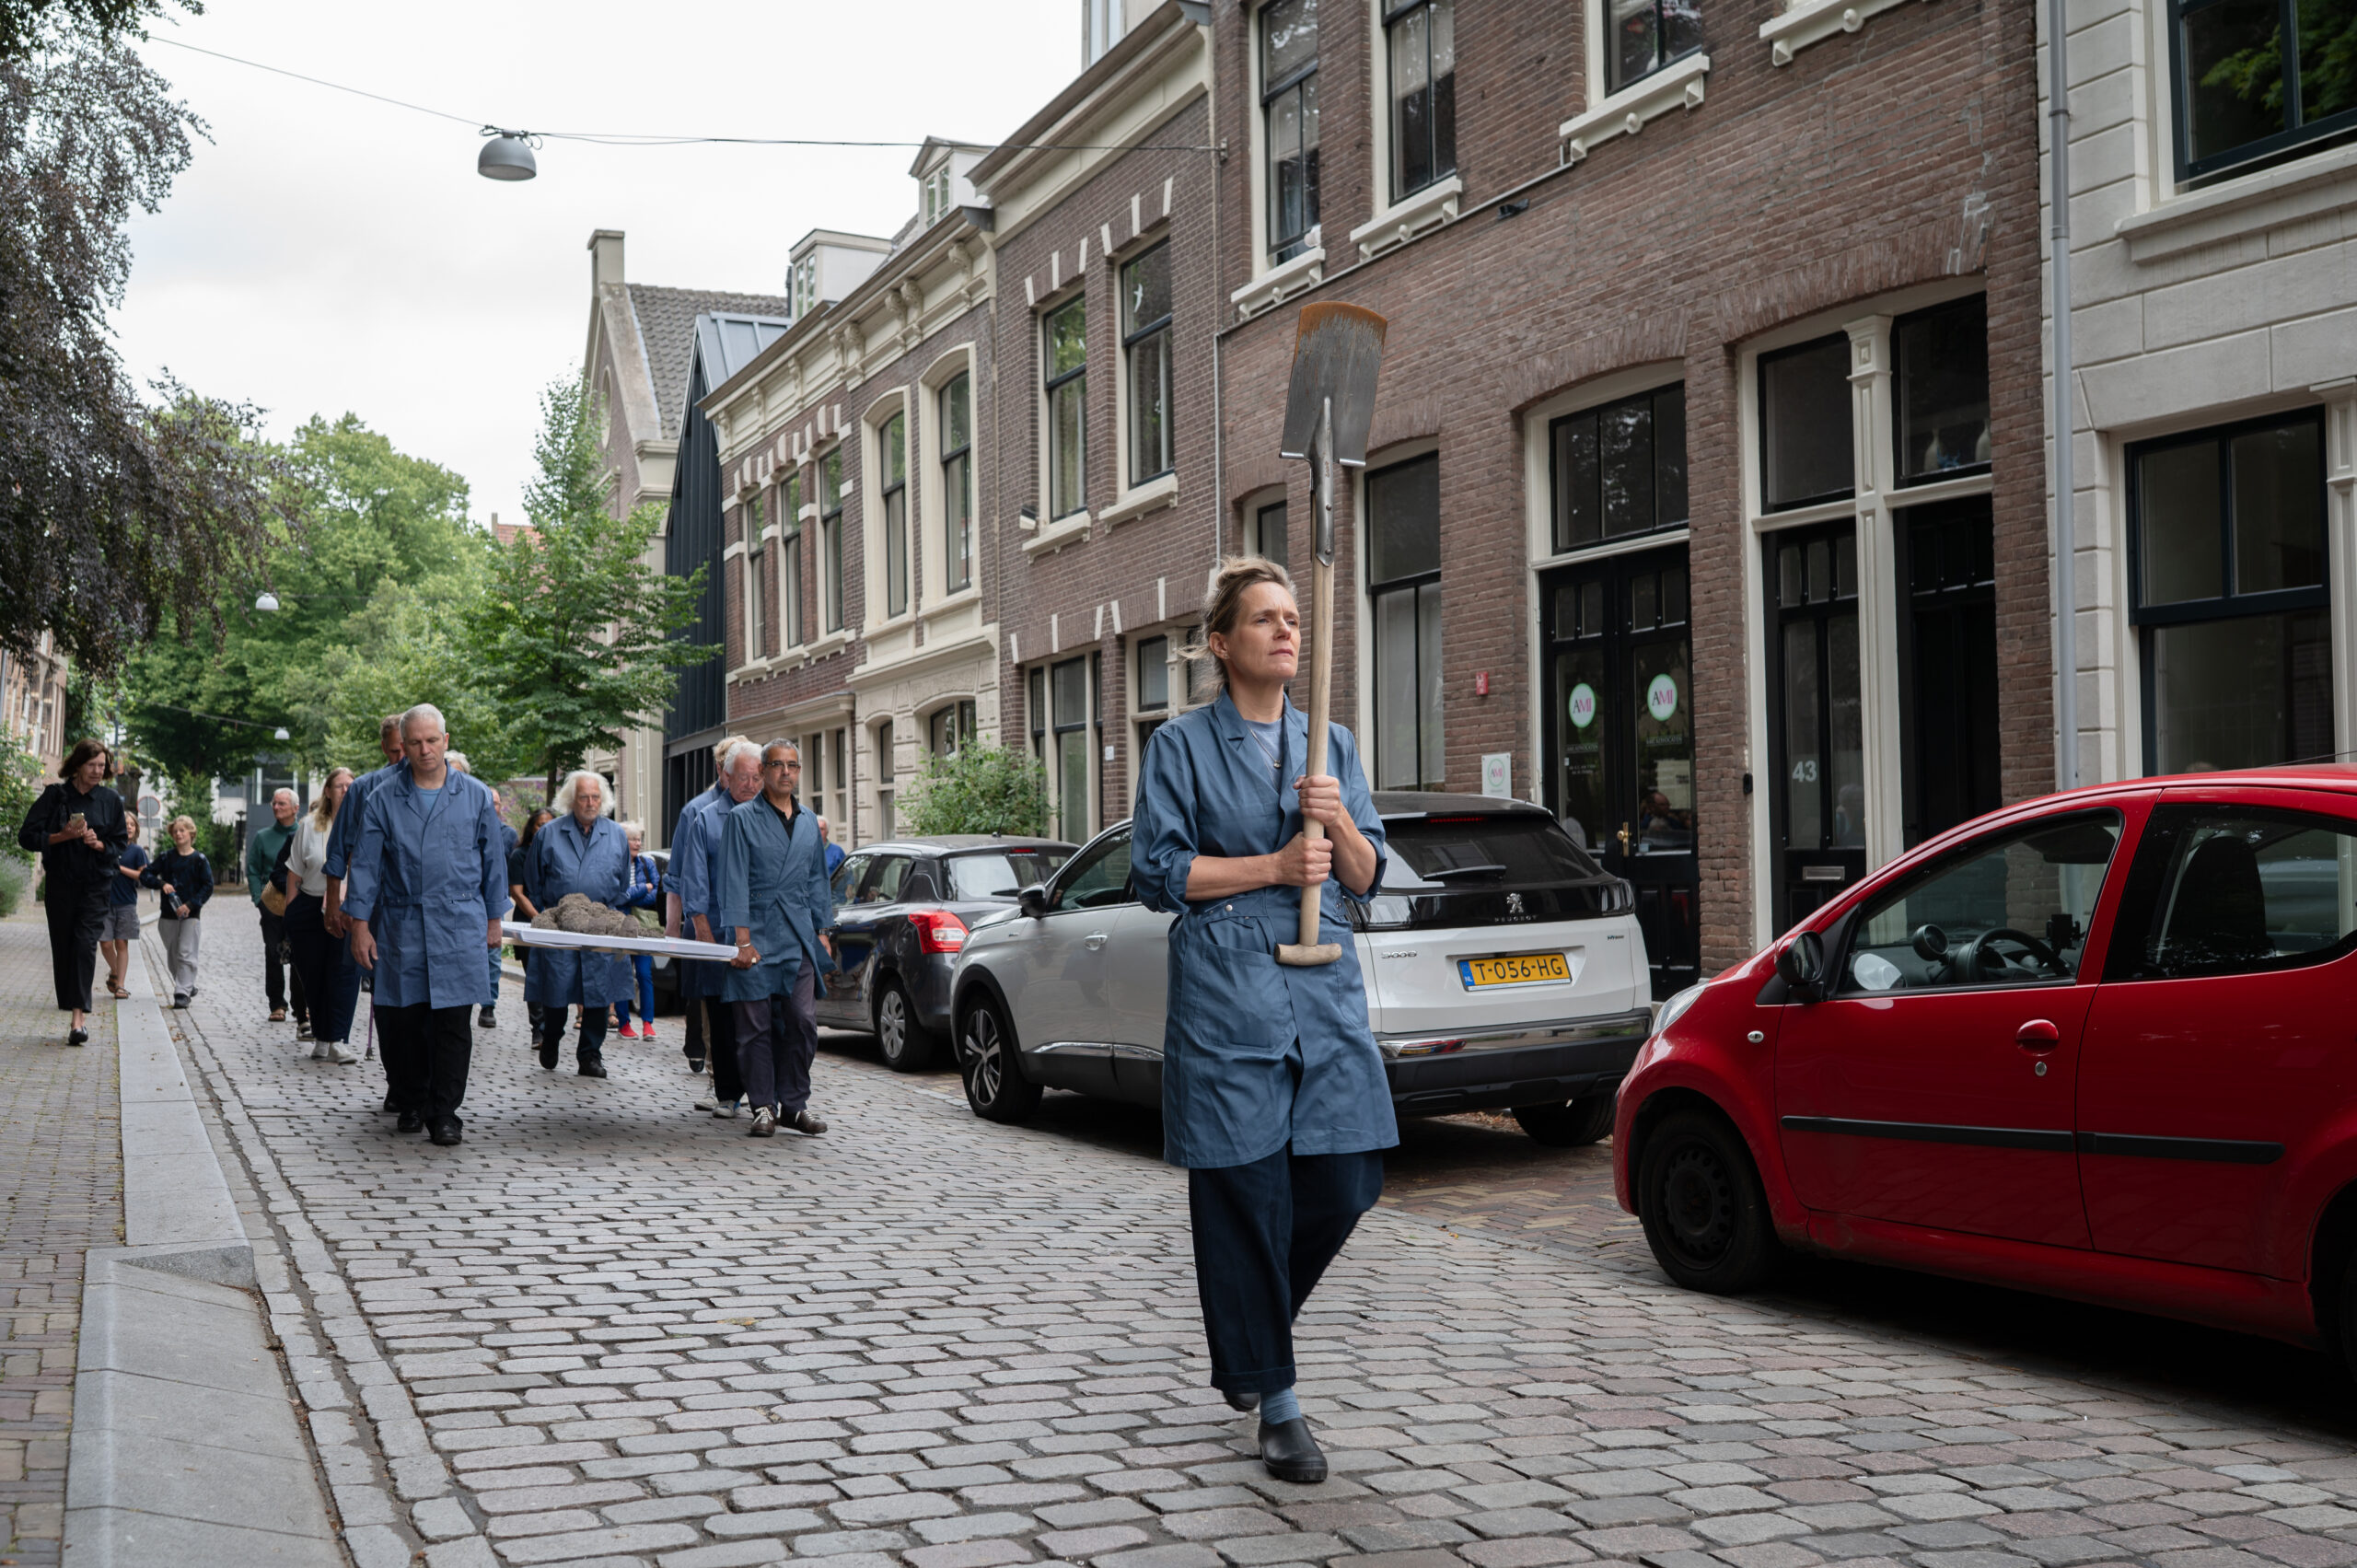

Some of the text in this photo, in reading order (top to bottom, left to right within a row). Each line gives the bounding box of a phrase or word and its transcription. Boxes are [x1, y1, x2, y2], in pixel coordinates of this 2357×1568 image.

[1572, 698, 1592, 714] AMI
[1651, 689, 1674, 707] AMI
[1792, 761, 1817, 783] 43
[1494, 914, 1538, 923] PEUGEOT
[1474, 958, 1563, 981] T-056-HG
